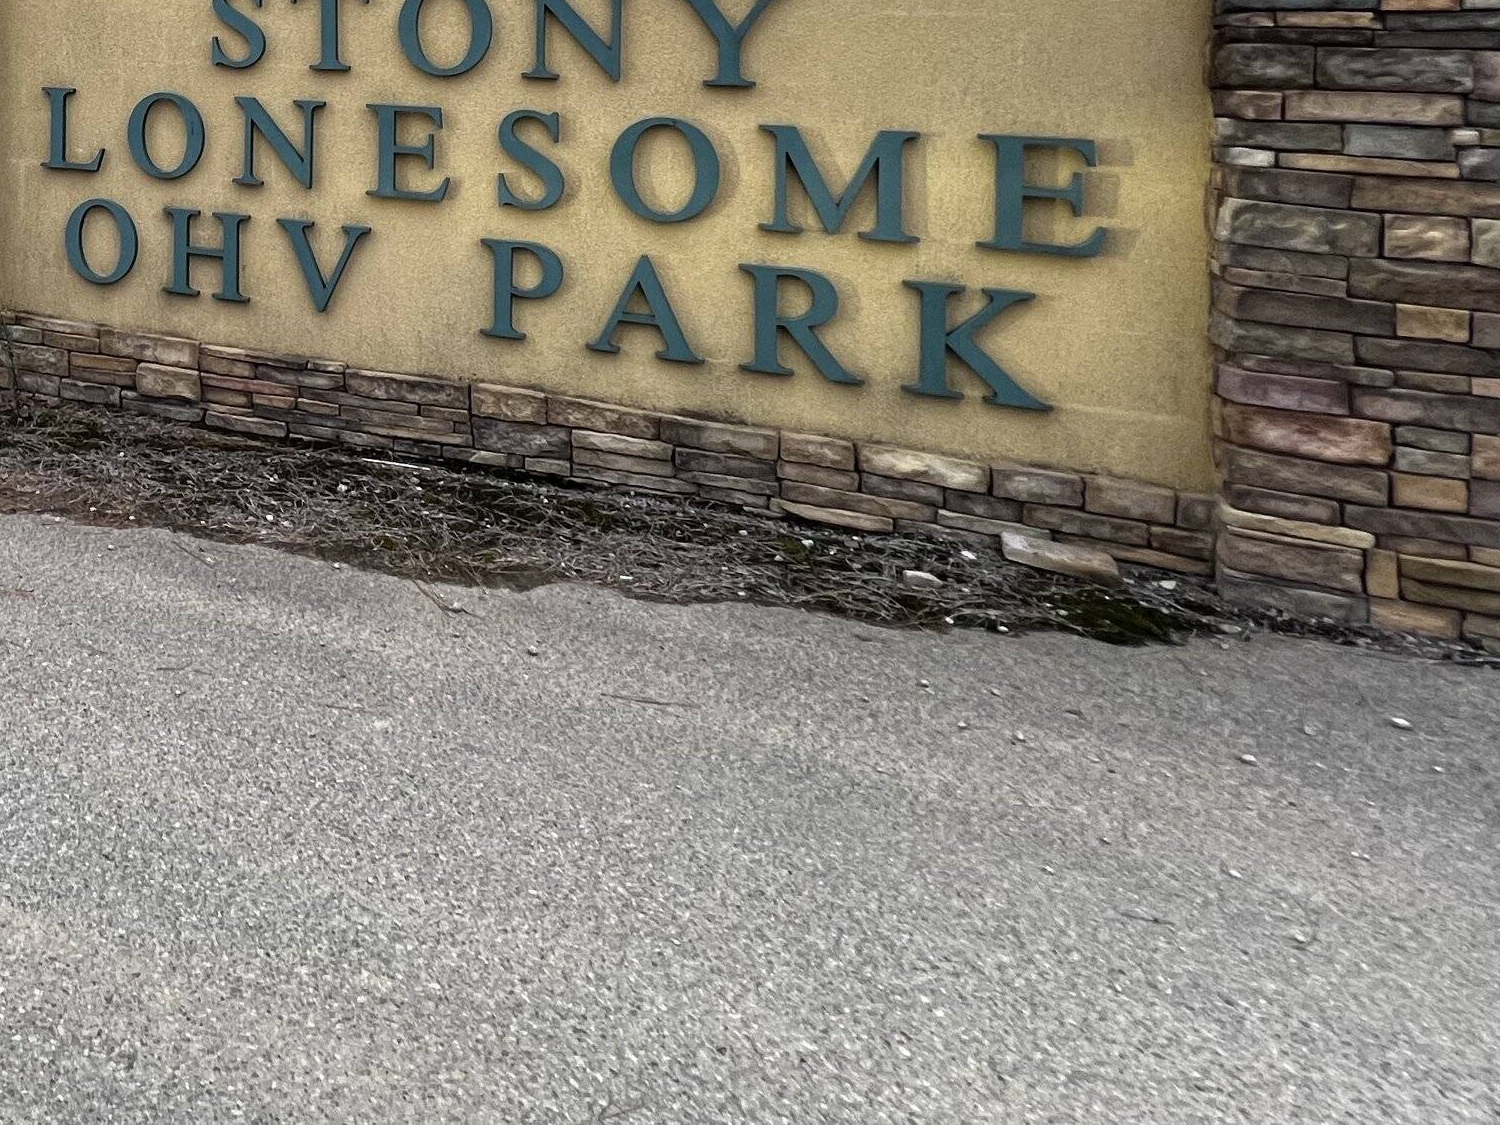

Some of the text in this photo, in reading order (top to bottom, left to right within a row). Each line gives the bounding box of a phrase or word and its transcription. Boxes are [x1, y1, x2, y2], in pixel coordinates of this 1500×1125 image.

[40, 86, 1108, 258] LONESOME
[64, 198, 1054, 413] OHV PARK
